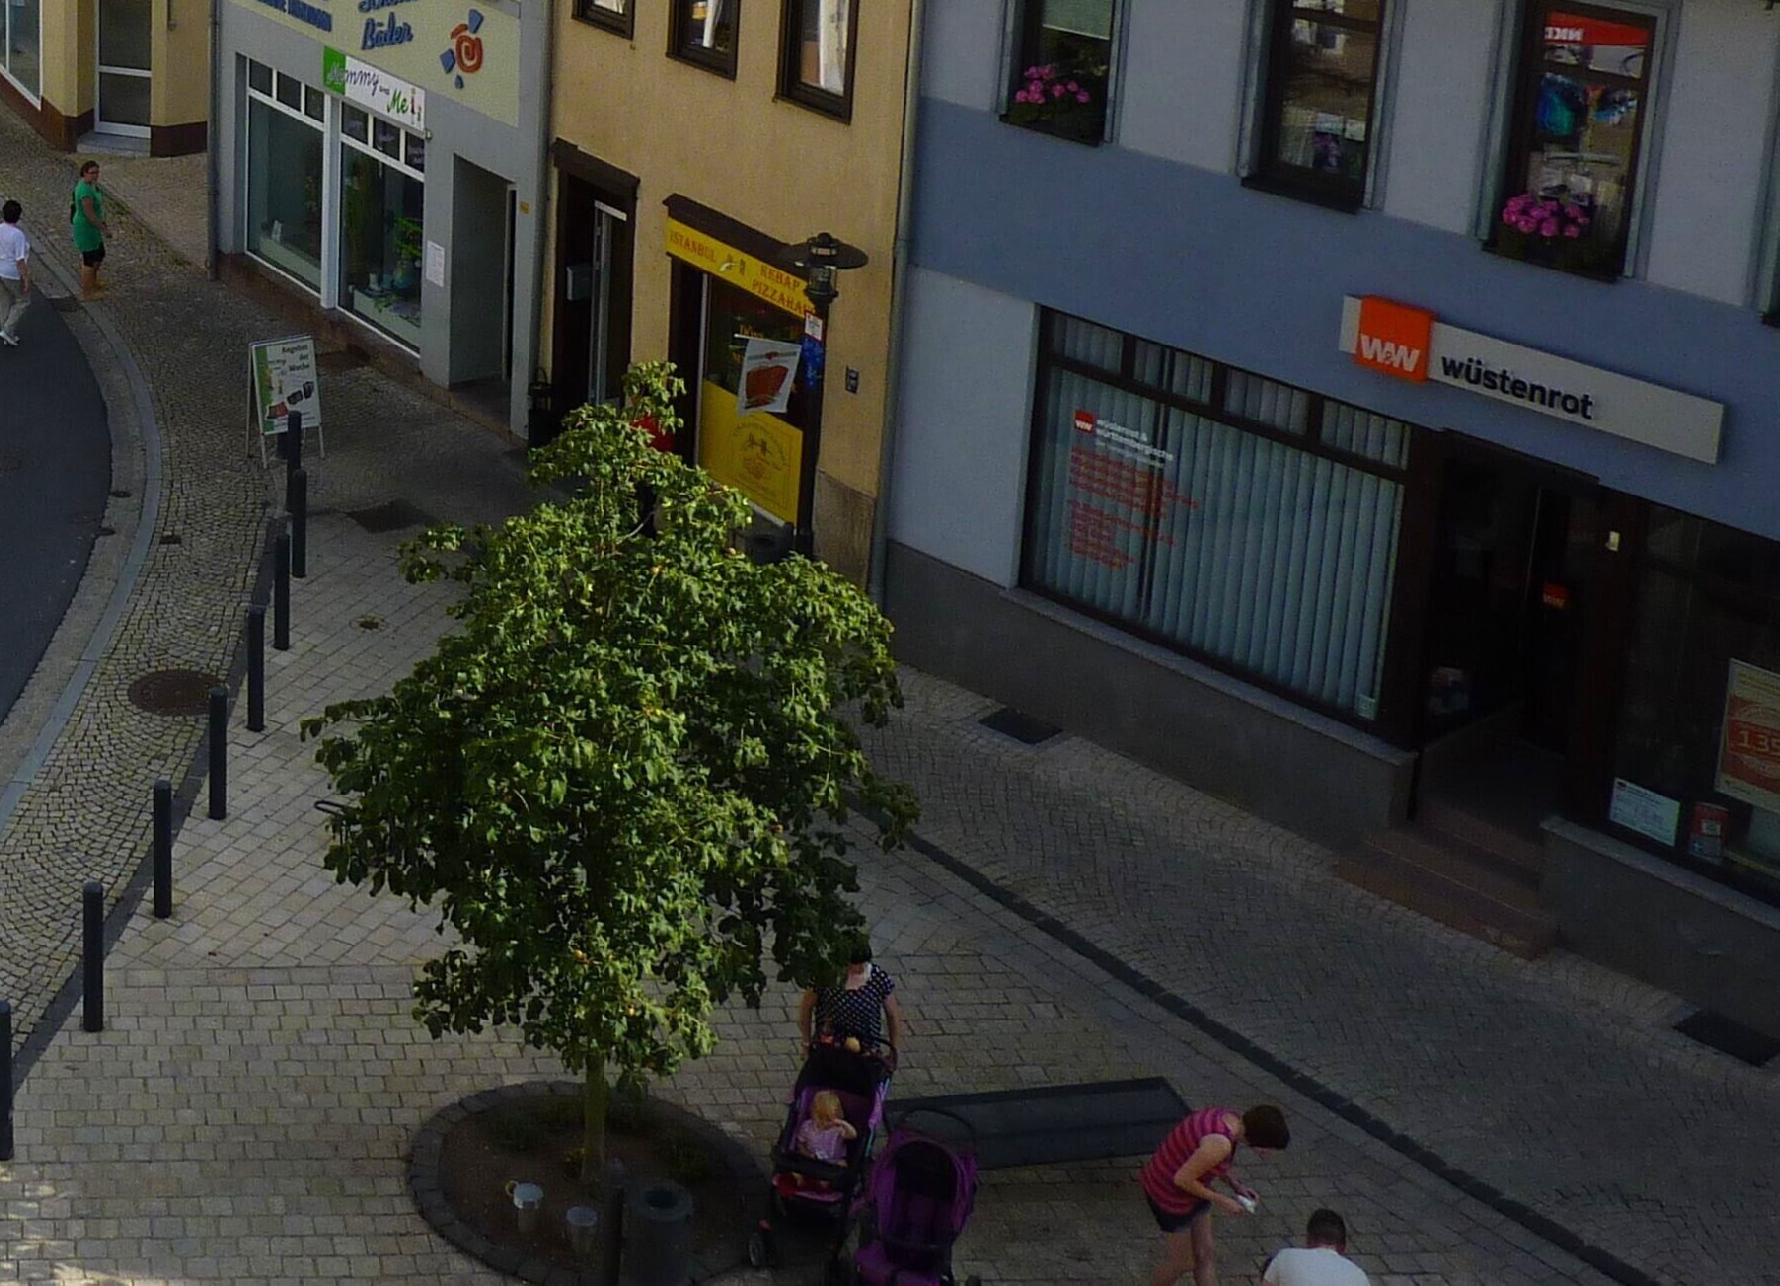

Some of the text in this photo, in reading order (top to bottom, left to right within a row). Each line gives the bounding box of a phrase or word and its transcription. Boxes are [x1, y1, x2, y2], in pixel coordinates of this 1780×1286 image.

[361, 11, 414, 50] Bäder
[386, 89, 410, 115] Me
[1441, 356, 1594, 420] wüstenrot
